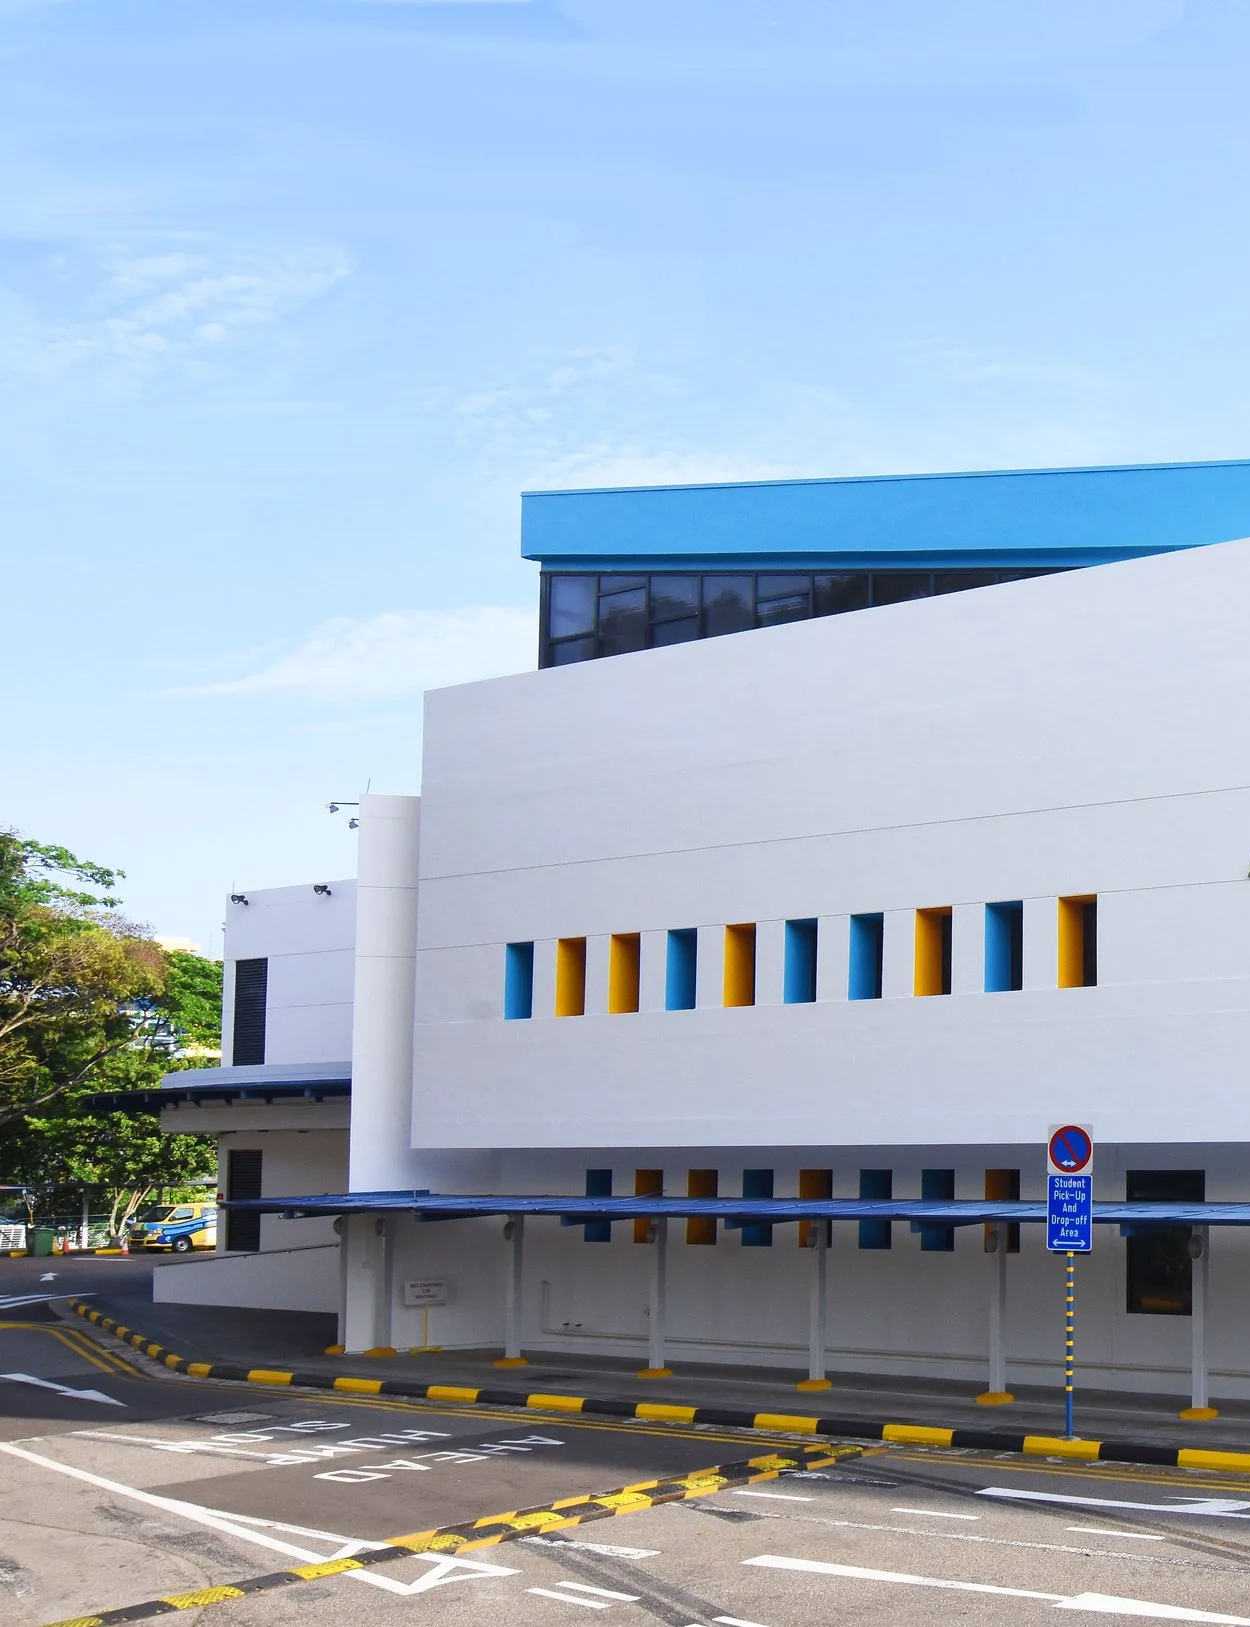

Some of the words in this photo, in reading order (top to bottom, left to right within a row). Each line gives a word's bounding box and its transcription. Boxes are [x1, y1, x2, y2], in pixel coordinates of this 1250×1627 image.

[1054, 1178, 1085, 1188] Student
[1053, 1190, 1086, 1203] Pick-Up
[1062, 1202, 1077, 1213] And
[1051, 1214, 1088, 1227] Drop-off
[1060, 1226, 1079, 1237] Area
[152, 1420, 351, 1453] SLOW
[266, 1429, 452, 1466] HUMP
[312, 1434, 566, 1483] AHEAD
